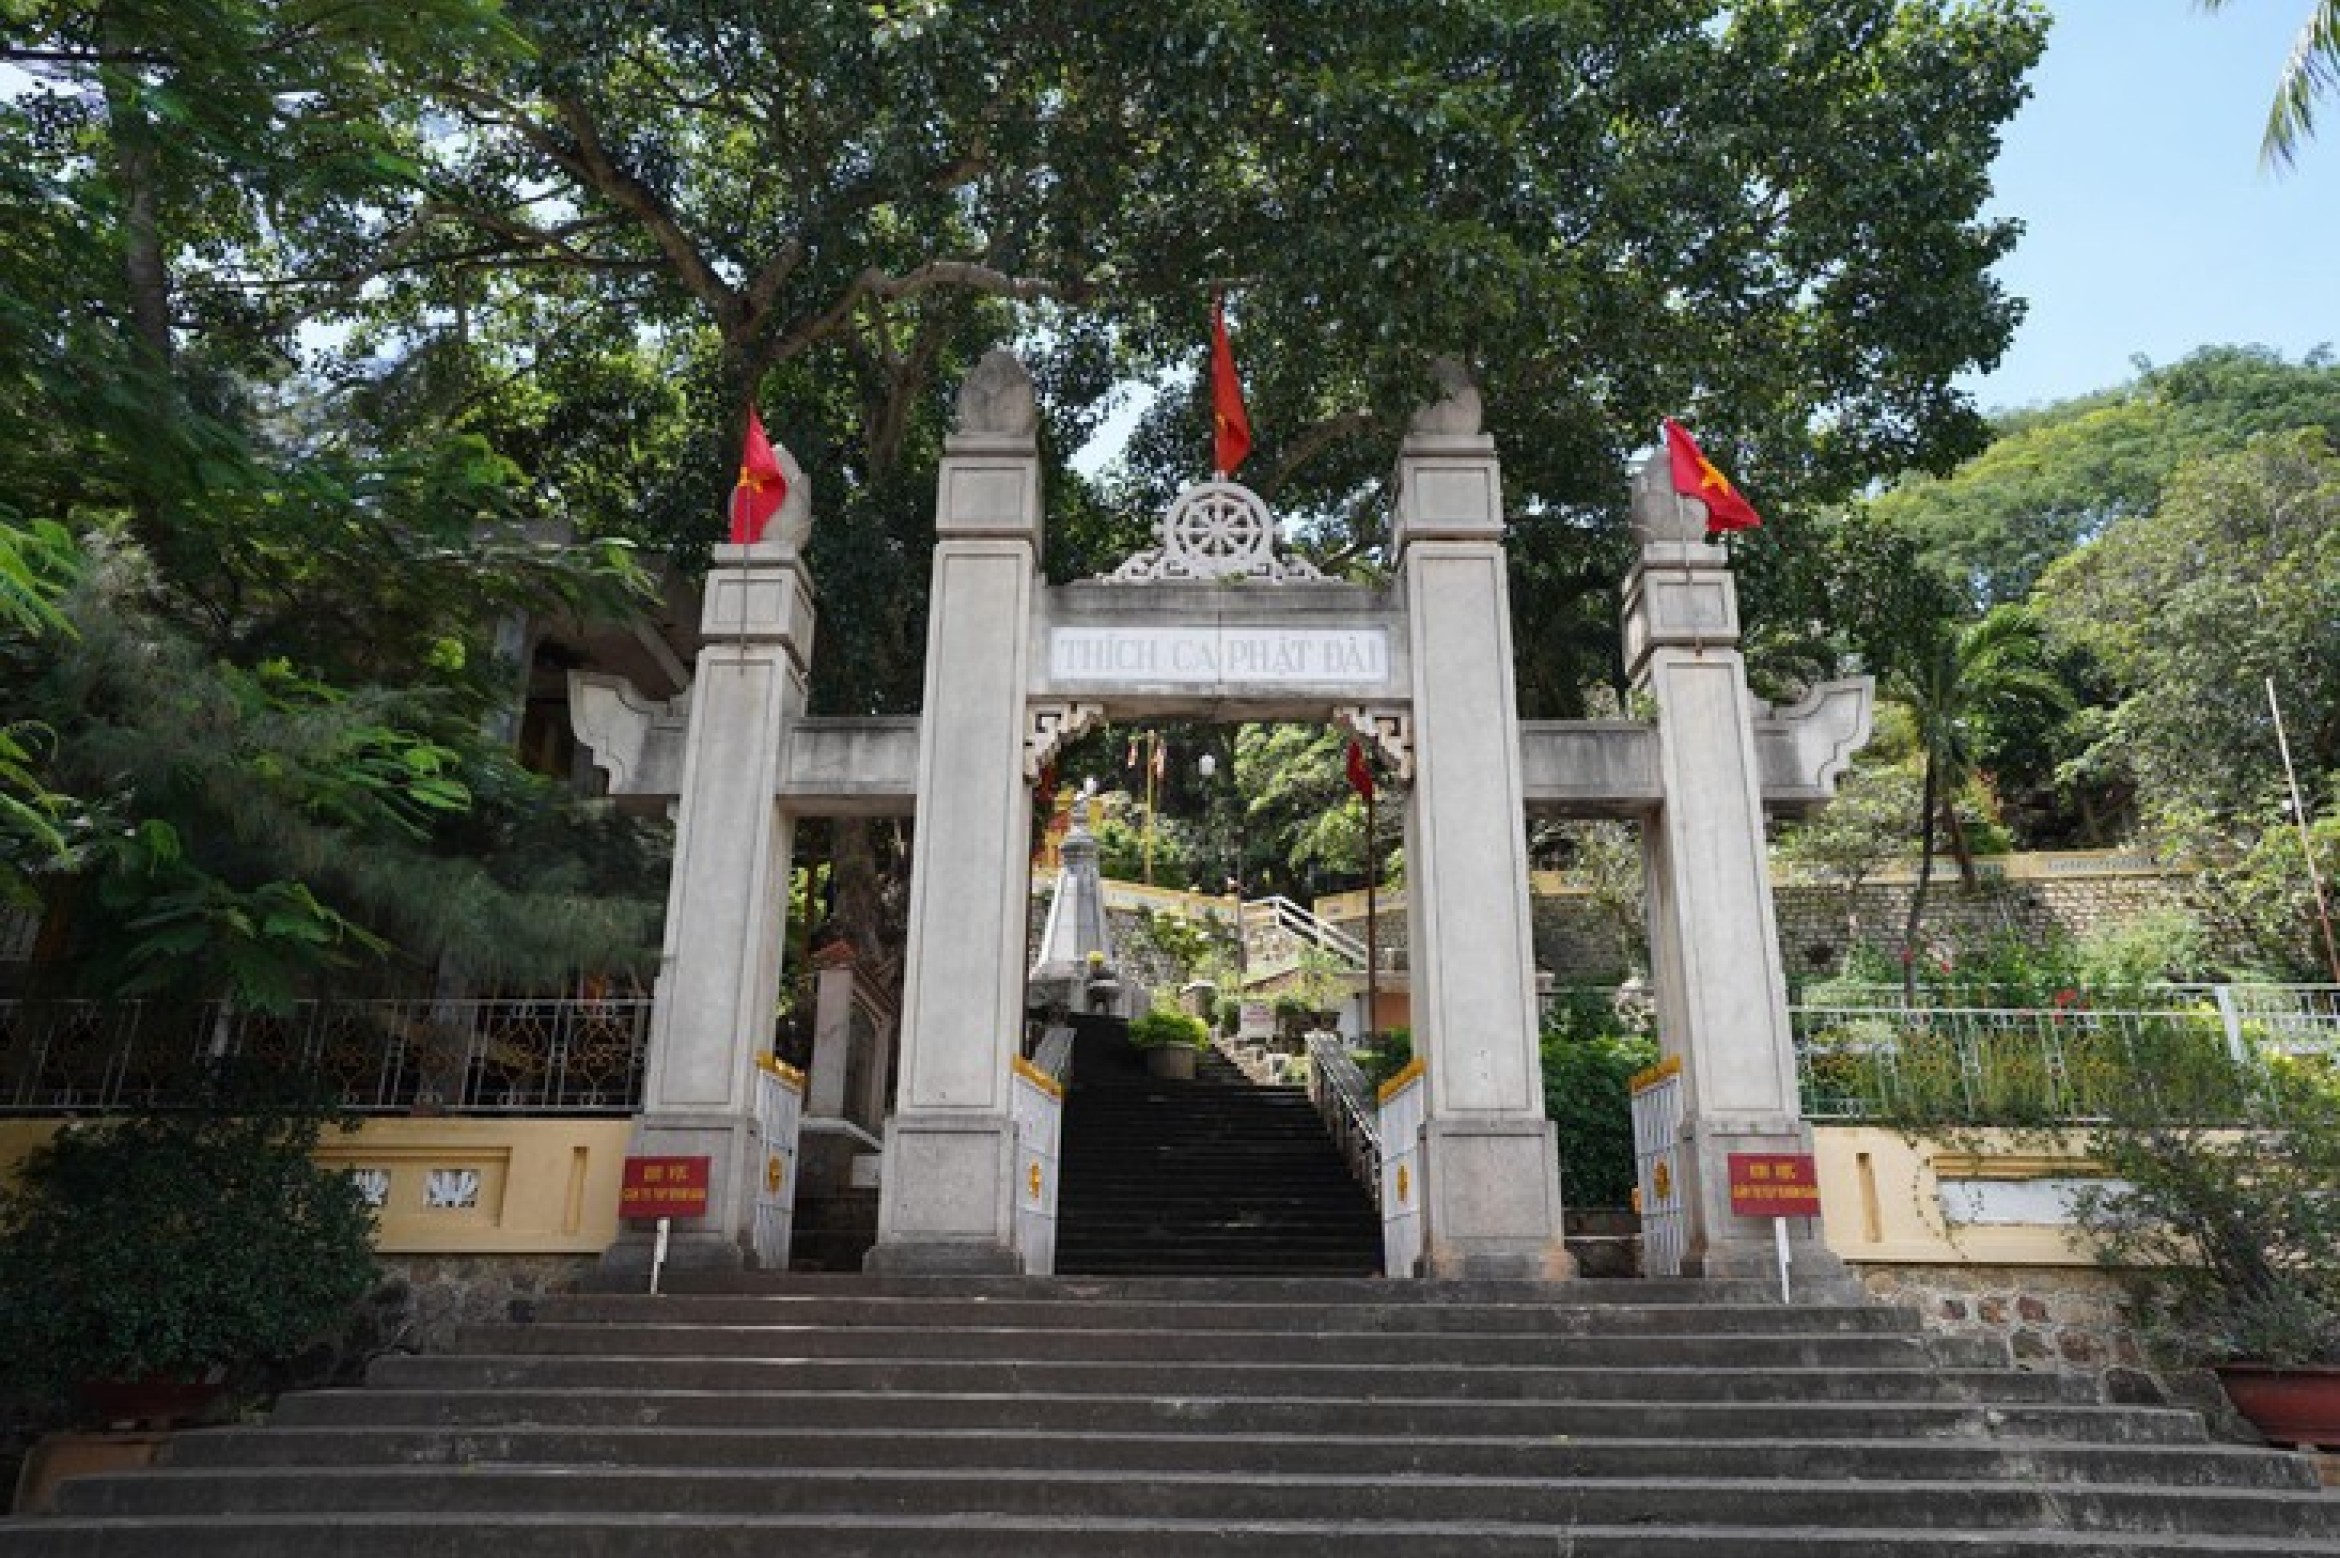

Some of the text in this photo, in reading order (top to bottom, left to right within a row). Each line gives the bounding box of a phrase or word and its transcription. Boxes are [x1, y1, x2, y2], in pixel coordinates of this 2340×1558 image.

[1061, 633, 1158, 670] THÍCH
[1173, 638, 1217, 671] CA
[1229, 633, 1310, 675] PHẬT
